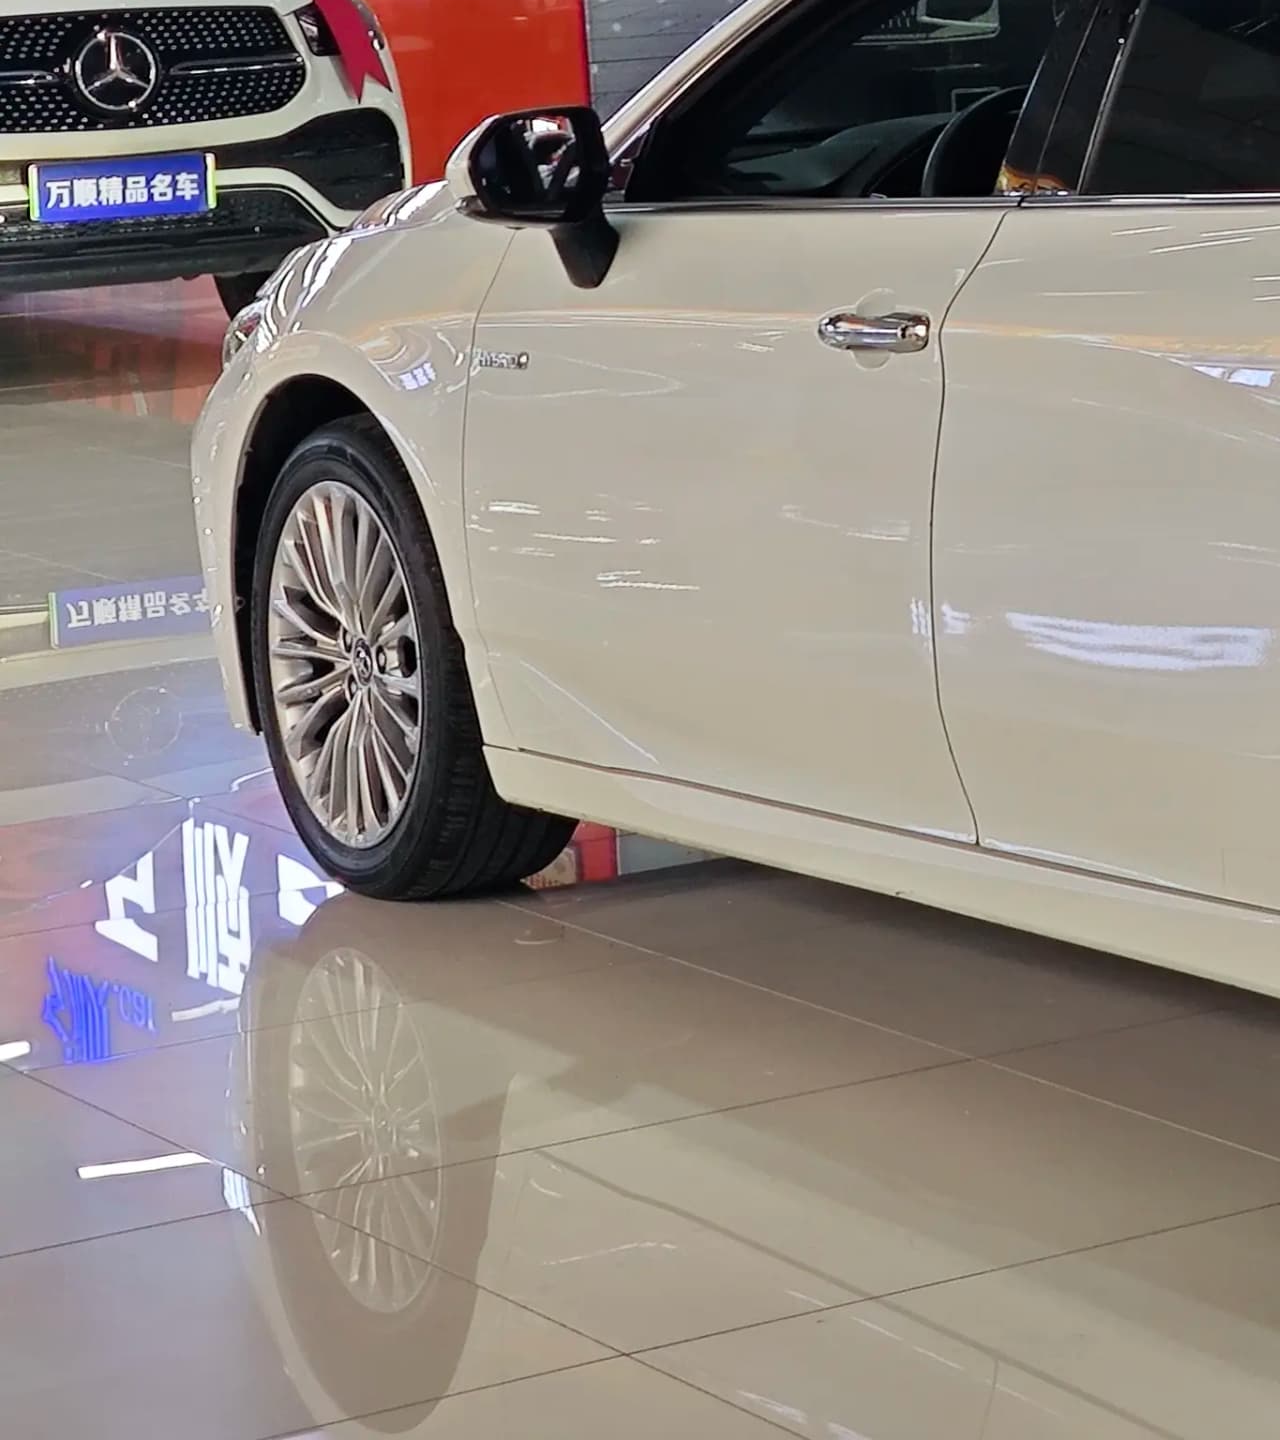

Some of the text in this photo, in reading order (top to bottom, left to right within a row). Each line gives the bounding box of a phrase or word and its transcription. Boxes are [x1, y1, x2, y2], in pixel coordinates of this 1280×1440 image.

[45, 170, 200, 209] 万顺精品名车
